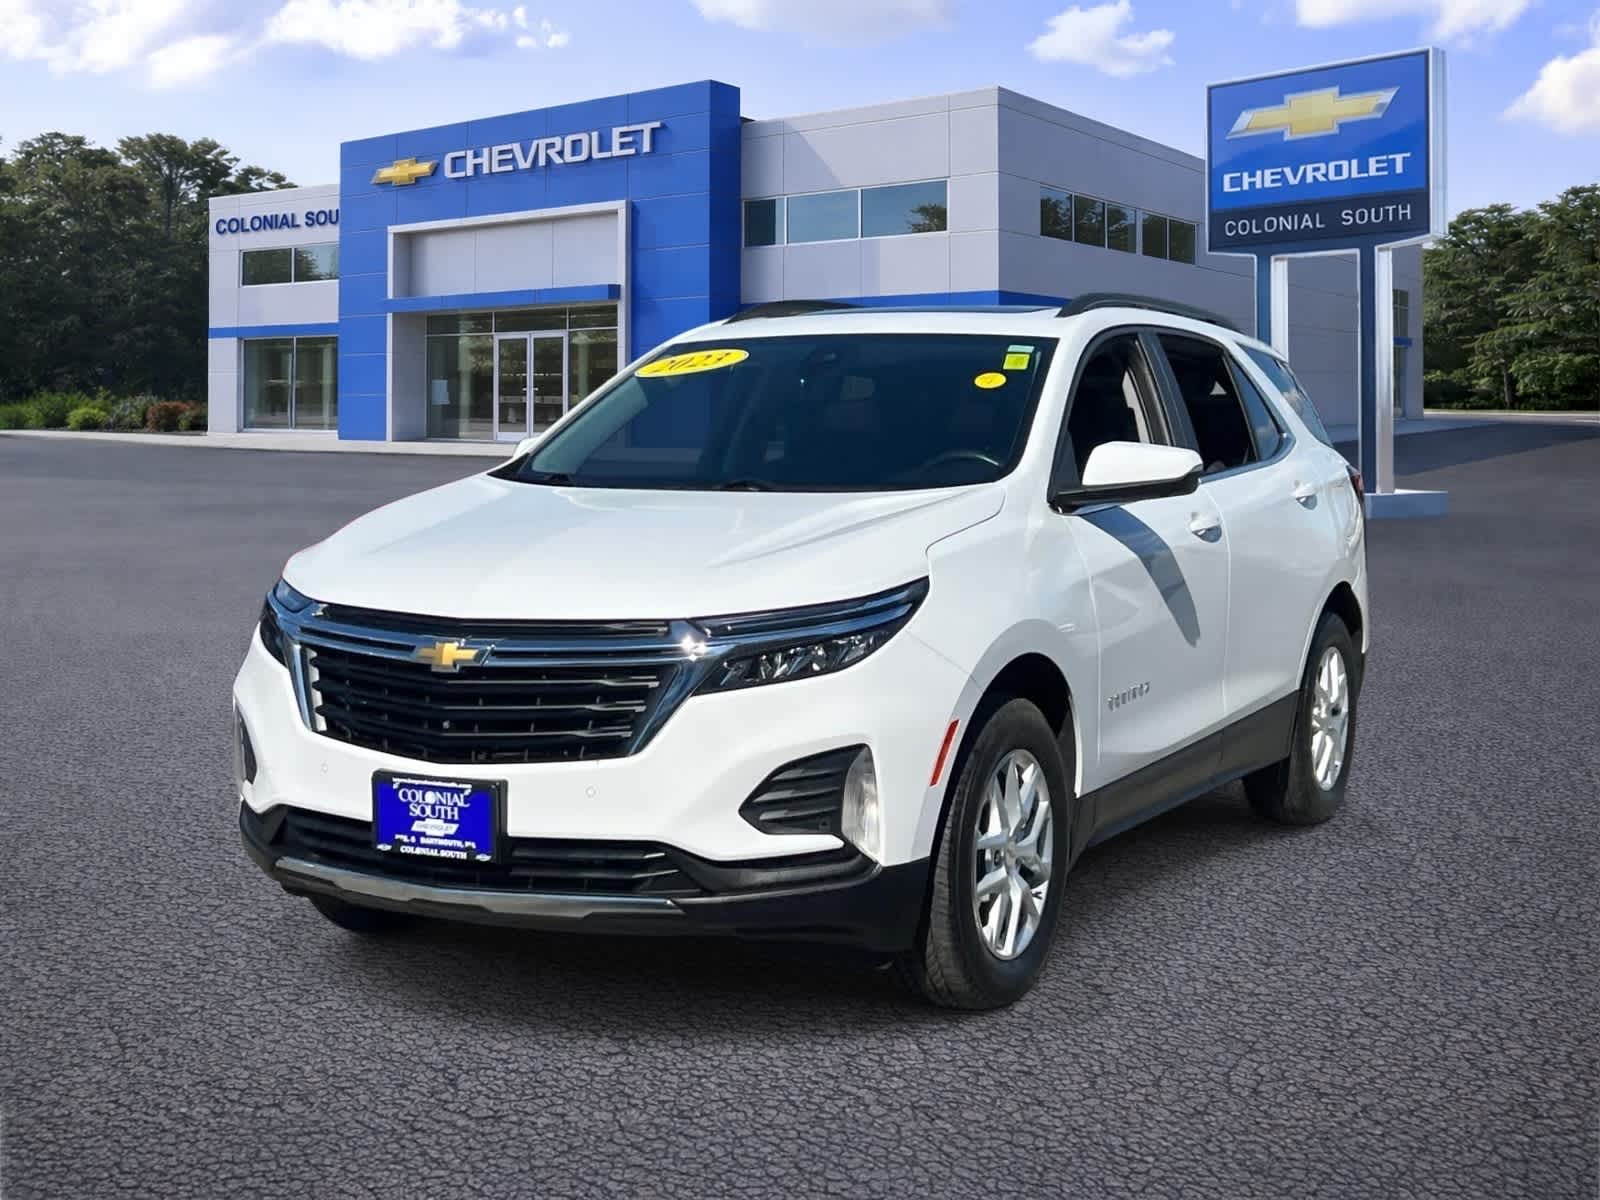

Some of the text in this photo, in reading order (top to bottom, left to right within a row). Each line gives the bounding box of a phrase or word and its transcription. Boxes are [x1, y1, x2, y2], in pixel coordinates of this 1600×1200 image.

[444, 121, 662, 179] CHEVROLET
[1223, 152, 1412, 193] CHEVROLET
[215, 203, 339, 235] COLONIAL SOU
[1224, 203, 1411, 237] COLONIAL SOUTH
[398, 788, 471, 807] COLONIAL
[409, 803, 459, 820] SOUTH
[400, 846, 467, 859] COLONIAL SOUTH
